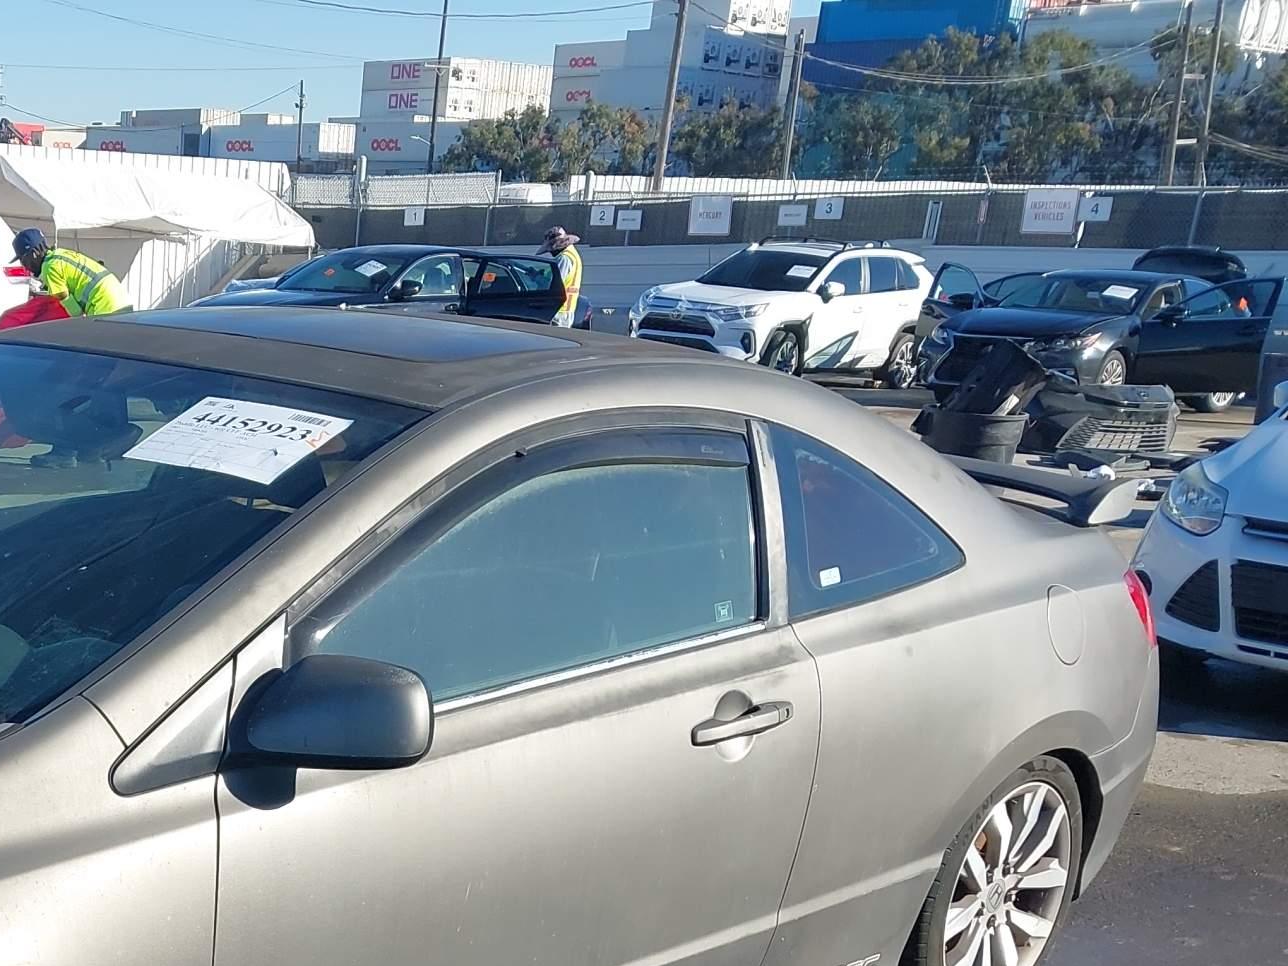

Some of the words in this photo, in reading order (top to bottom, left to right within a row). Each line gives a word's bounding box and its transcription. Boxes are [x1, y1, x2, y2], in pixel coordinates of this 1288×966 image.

[569, 56, 597, 68] OOCL
[391, 63, 421, 79] ONE
[388, 93, 418, 109] ONE
[101, 141, 126, 152] OOCL
[226, 140, 254, 152] OOCL
[371, 139, 401, 151] OOCL
[825, 203, 832, 214] 3
[1091, 203, 1099, 215] 4
[599, 210, 606, 221] 2
[192, 411, 313, 442] 44152923
